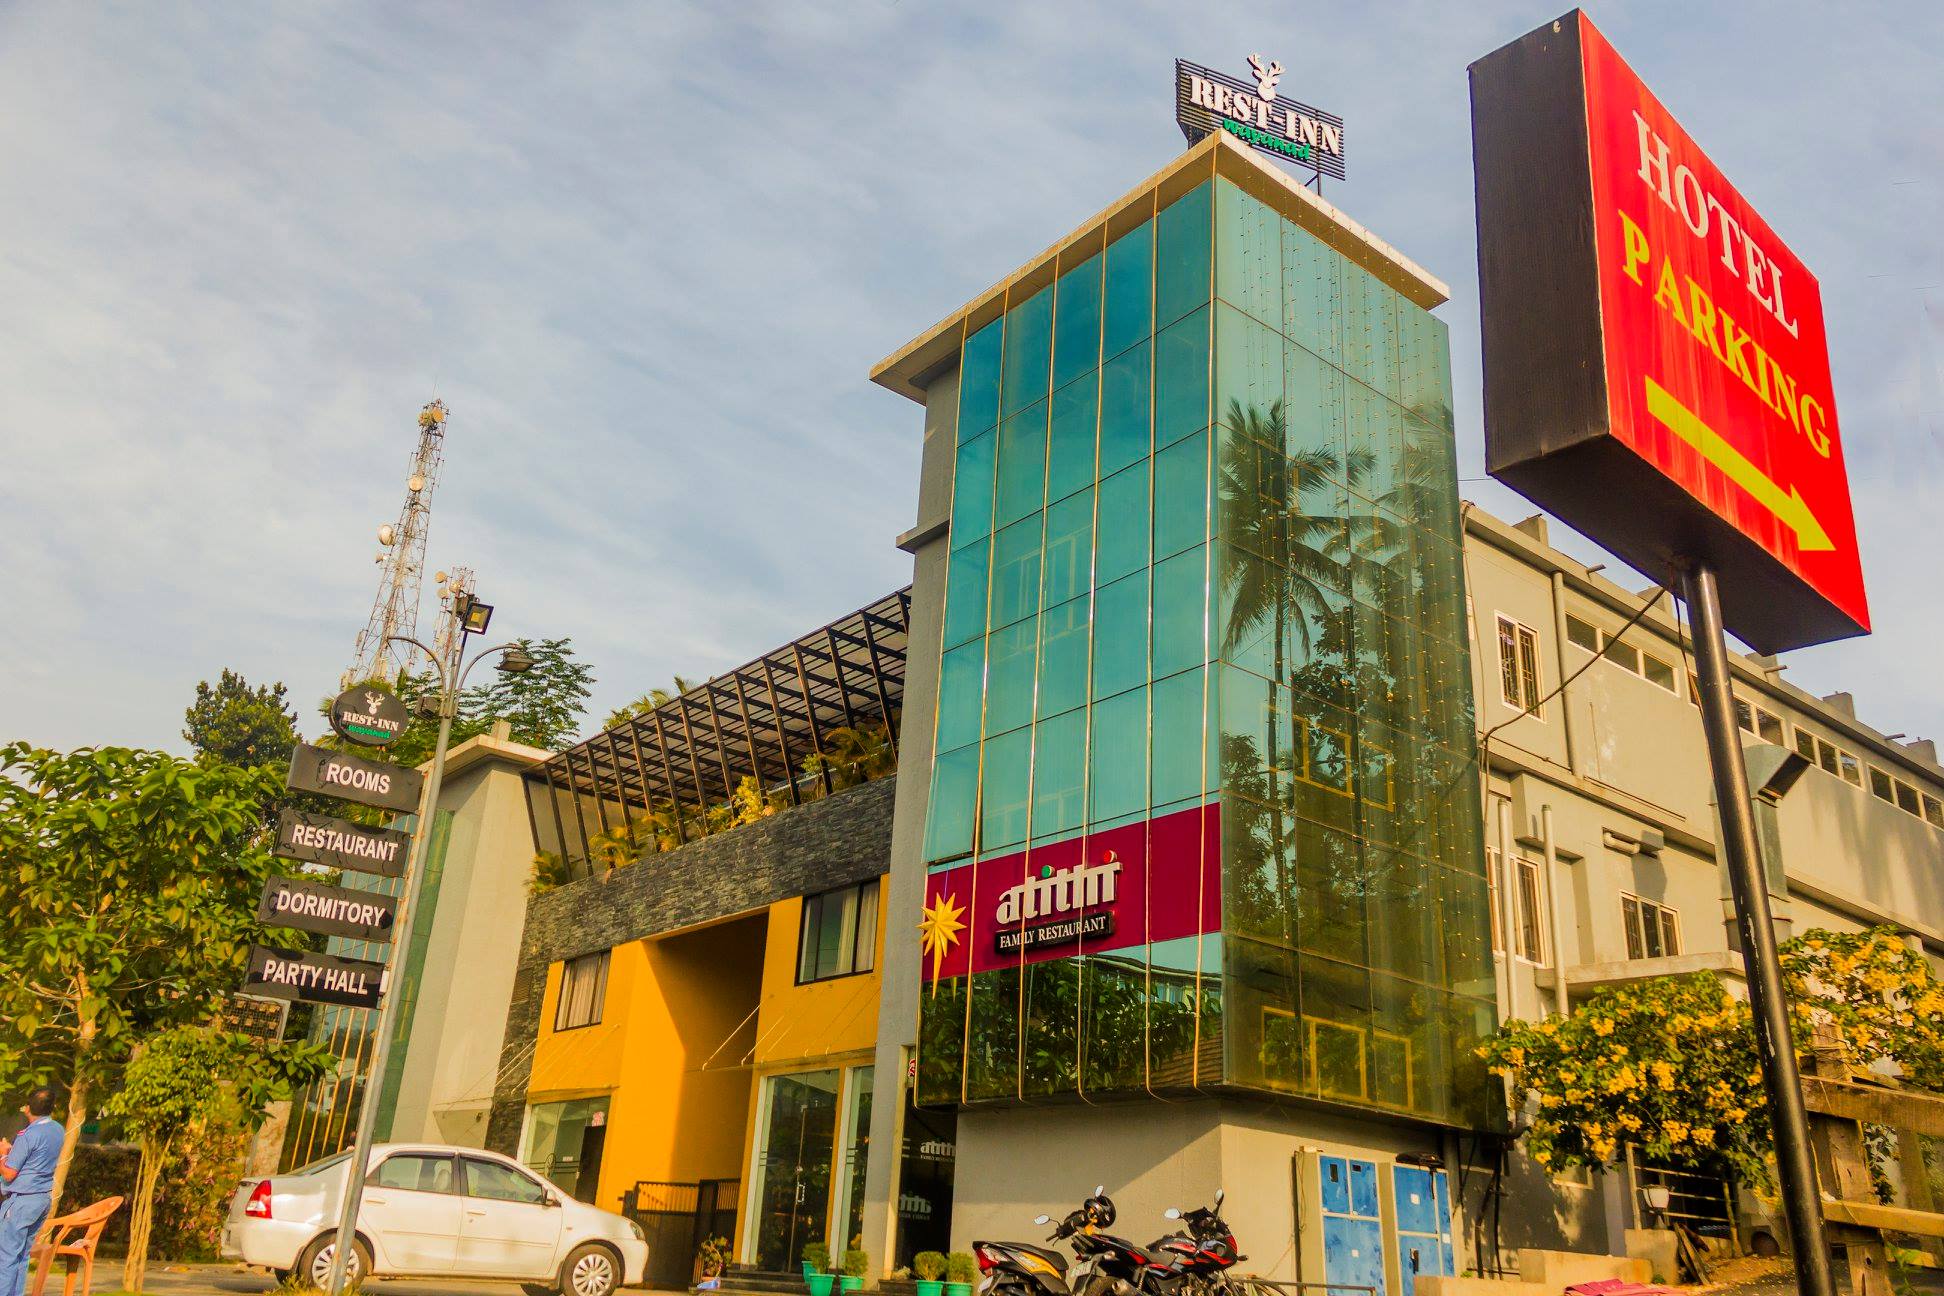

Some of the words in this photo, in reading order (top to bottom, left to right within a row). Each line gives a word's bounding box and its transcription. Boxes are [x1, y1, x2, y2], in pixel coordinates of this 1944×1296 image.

[1189, 75, 1341, 155] REST-INN
[1223, 117, 1310, 159] wayanad
[1632, 110, 1798, 339] HOTEL
[1618, 209, 1830, 459] PARKING
[343, 711, 399, 731] REST-INN
[325, 762, 391, 794] ROOMS
[291, 824, 398, 862] RESTAURANT
[276, 889, 386, 927] DORMITORY
[1038, 916, 1106, 942] RESTAURANT
[262, 959, 323, 989] PARTY
[323, 968, 368, 995] HALL
